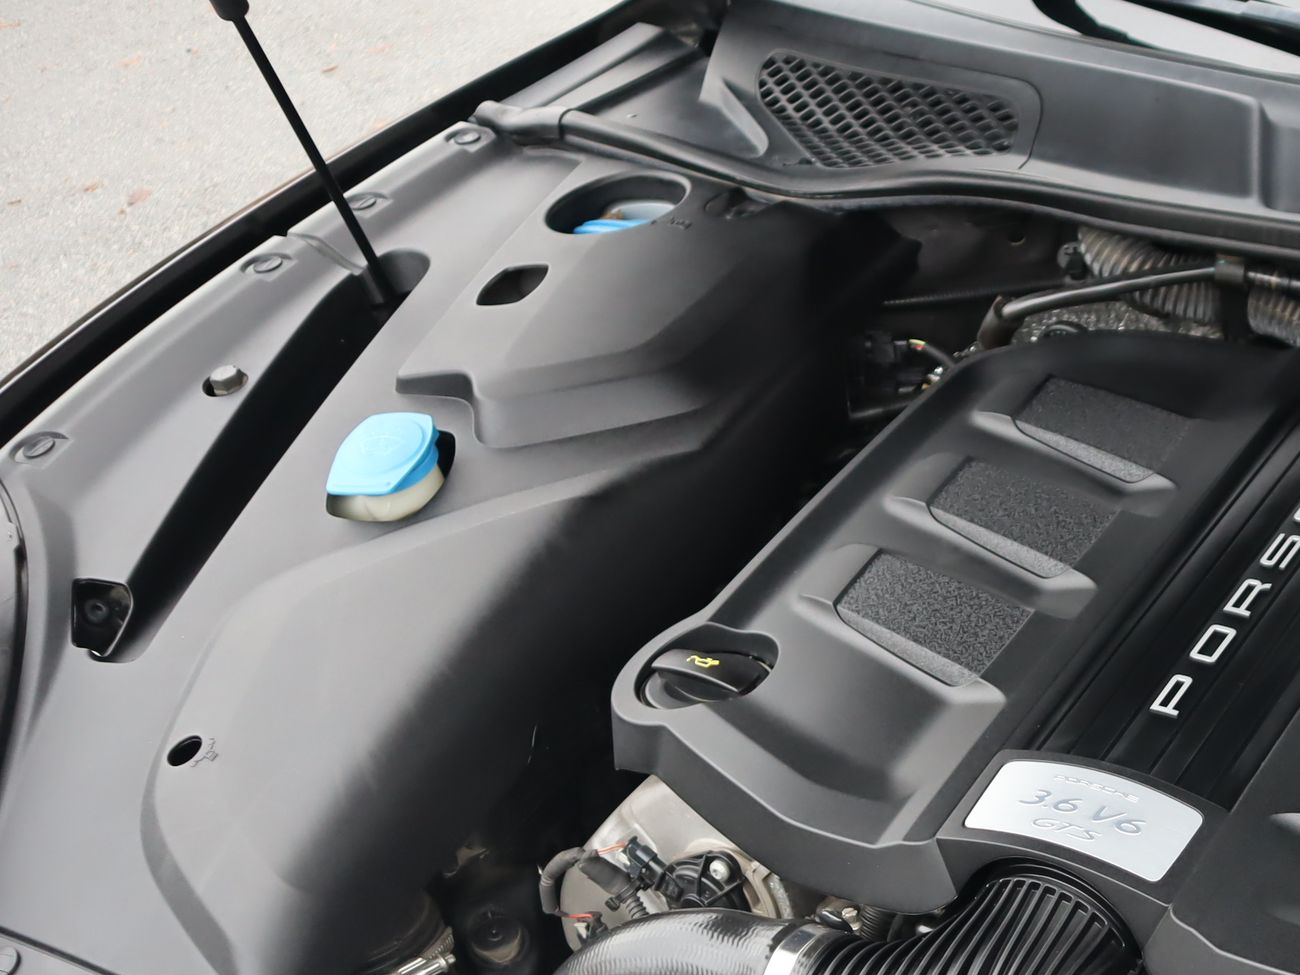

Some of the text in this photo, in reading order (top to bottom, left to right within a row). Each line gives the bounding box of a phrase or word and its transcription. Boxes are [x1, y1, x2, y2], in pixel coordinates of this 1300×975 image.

[1018, 788, 1147, 835] 3.6 V6
[1031, 817, 1102, 841] GTS
